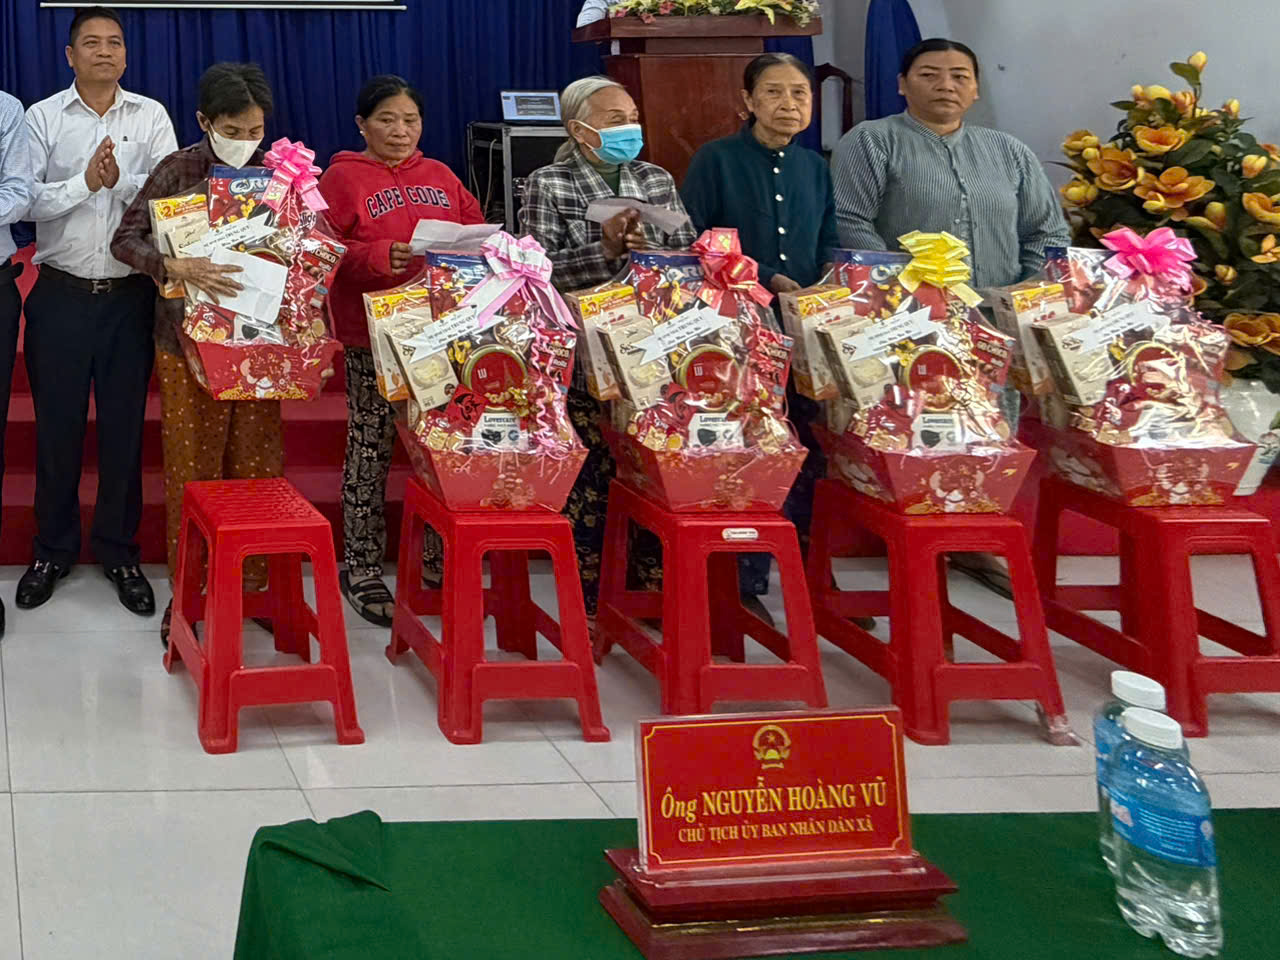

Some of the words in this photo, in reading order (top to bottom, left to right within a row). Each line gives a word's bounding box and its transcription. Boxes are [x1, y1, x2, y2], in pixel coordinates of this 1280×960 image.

[366, 187, 405, 220] CAPE
[661, 786, 697, 823] Ông
[702, 776, 783, 816] NGUYỄN
[786, 778, 856, 811] HOÀNG
[860, 775, 887, 807] VŨ
[678, 822, 706, 842] CHỦ
[708, 825, 739, 844] TỊCH
[741, 820, 759, 839] ỦY
[762, 822, 787, 837] BAN
[789, 817, 826, 836] NHÂN
[828, 815, 855, 833] DÂN
[856, 814, 874, 831] XÃ
